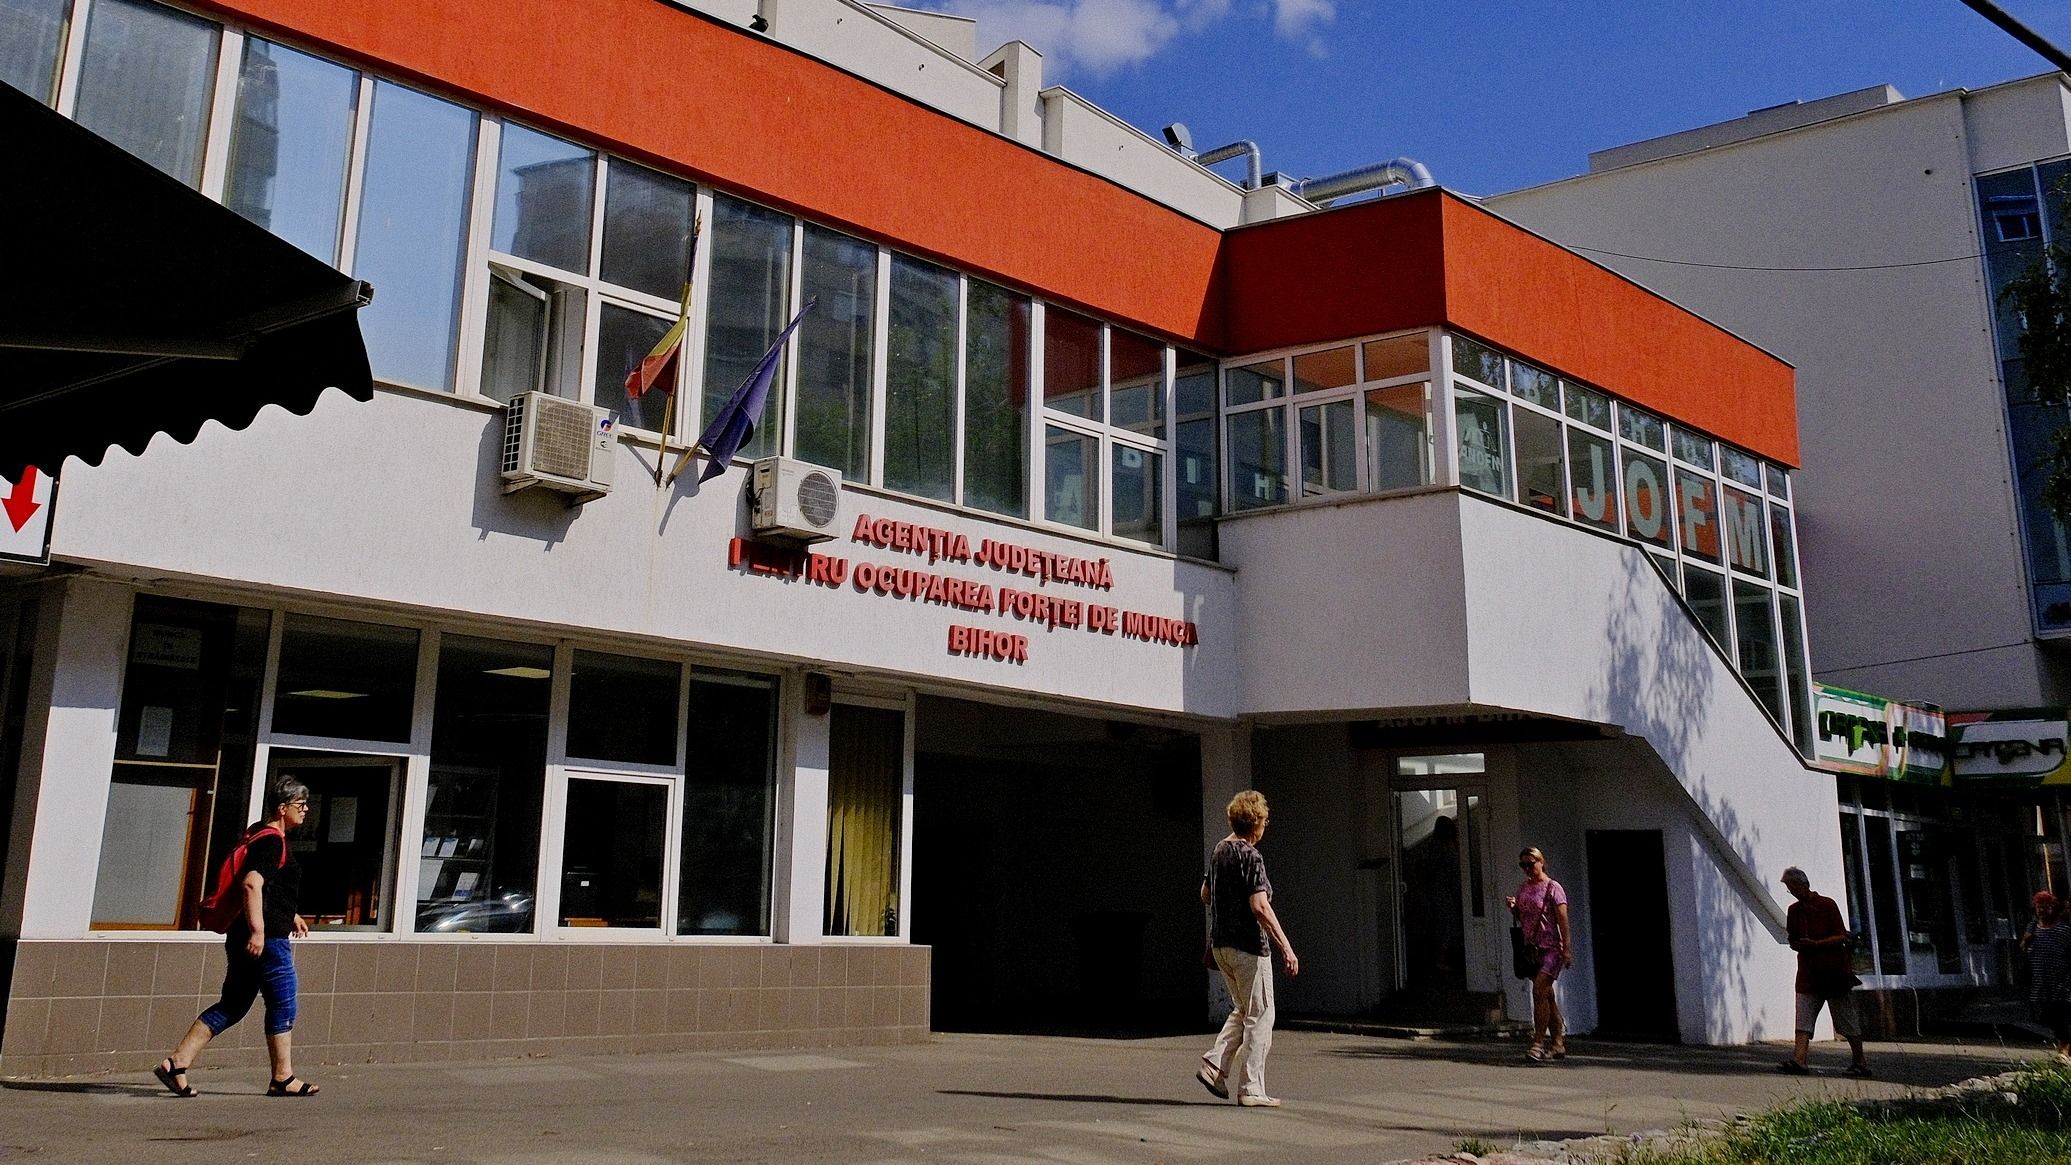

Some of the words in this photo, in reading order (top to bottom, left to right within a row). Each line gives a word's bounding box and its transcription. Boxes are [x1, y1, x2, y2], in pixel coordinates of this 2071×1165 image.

[853, 562, 995, 610] OCUPAREA
[1088, 604, 1119, 631] DE
[949, 624, 1029, 661] BIHOR
